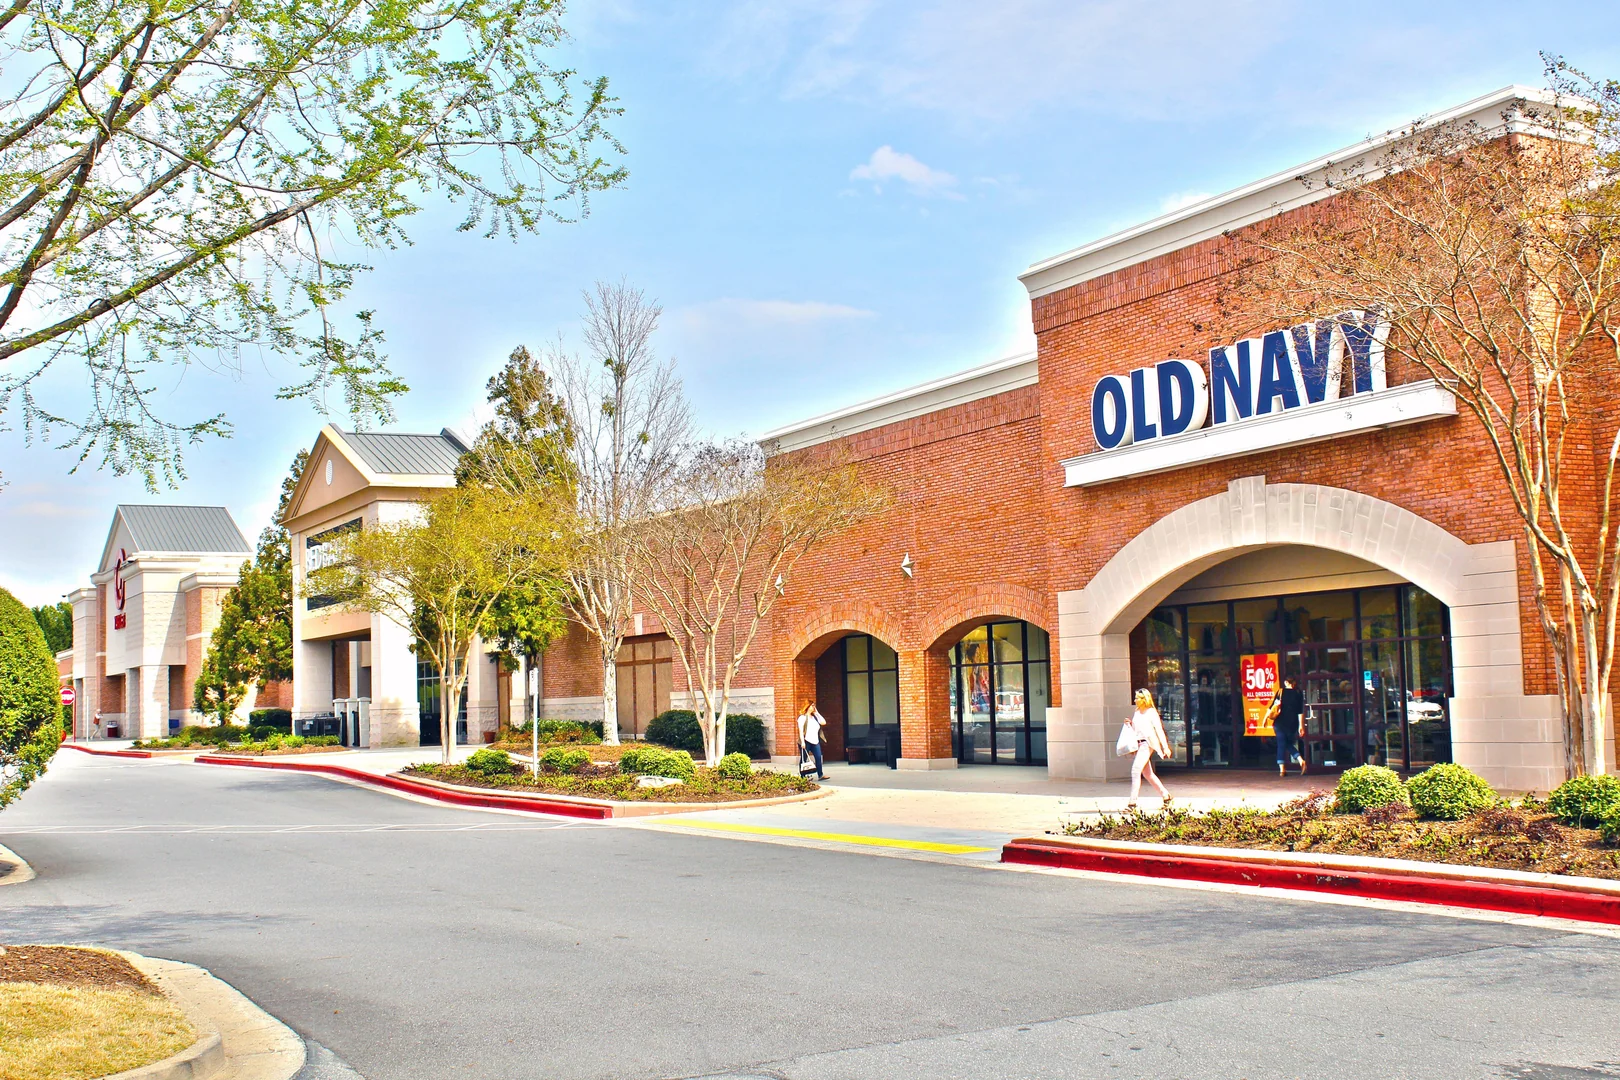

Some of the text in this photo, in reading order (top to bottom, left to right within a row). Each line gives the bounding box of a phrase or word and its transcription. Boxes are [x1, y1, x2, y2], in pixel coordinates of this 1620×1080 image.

[1091, 303, 1389, 451] OLD NAVY
[1246, 667, 1274, 689] 50% off
